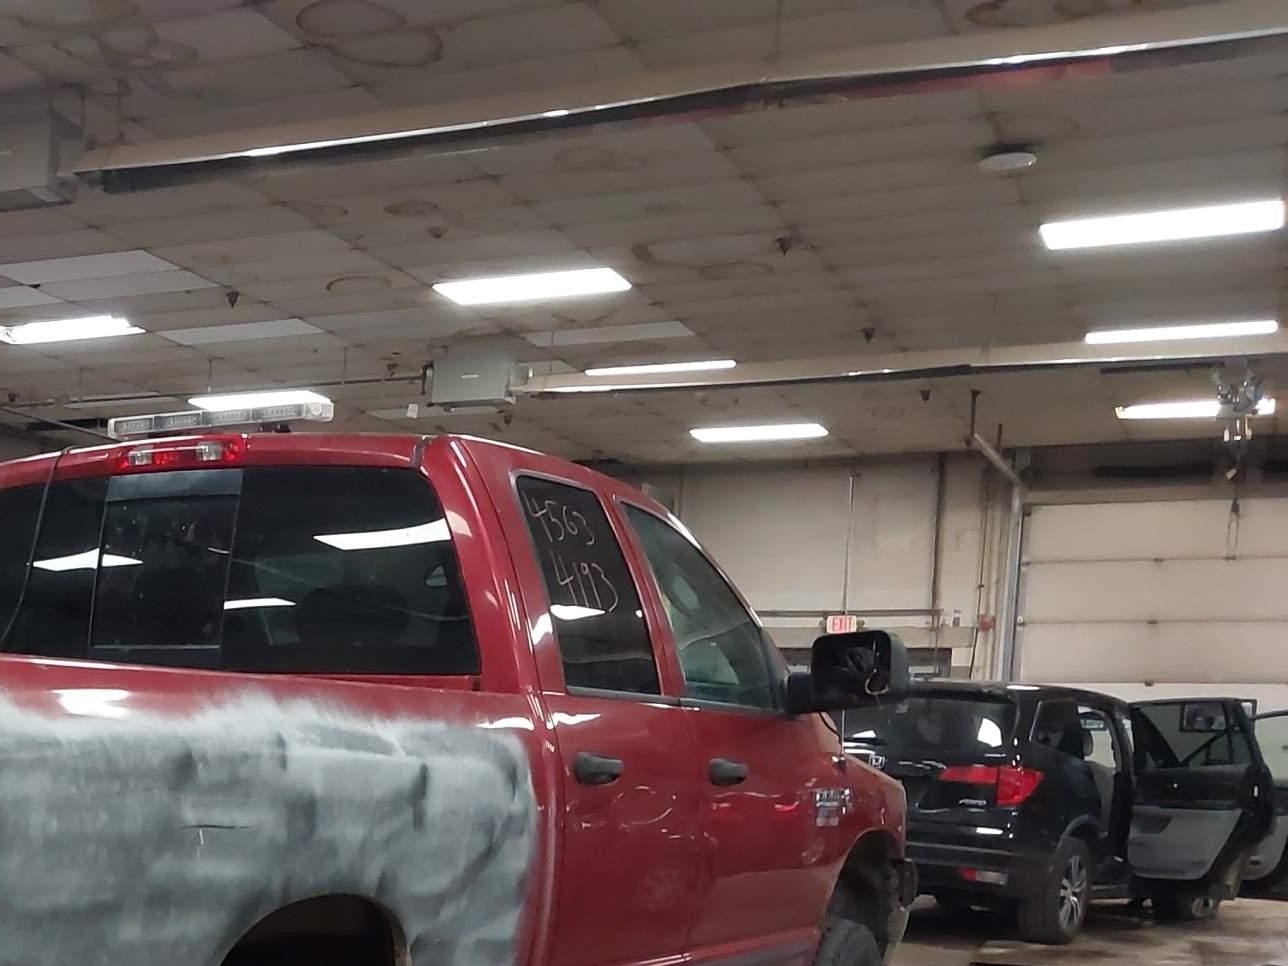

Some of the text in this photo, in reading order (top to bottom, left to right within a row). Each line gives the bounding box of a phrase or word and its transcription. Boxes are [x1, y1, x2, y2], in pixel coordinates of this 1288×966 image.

[521, 489, 595, 546] 4563
[550, 549, 618, 613] 4193
[832, 616, 854, 632] EXIT
